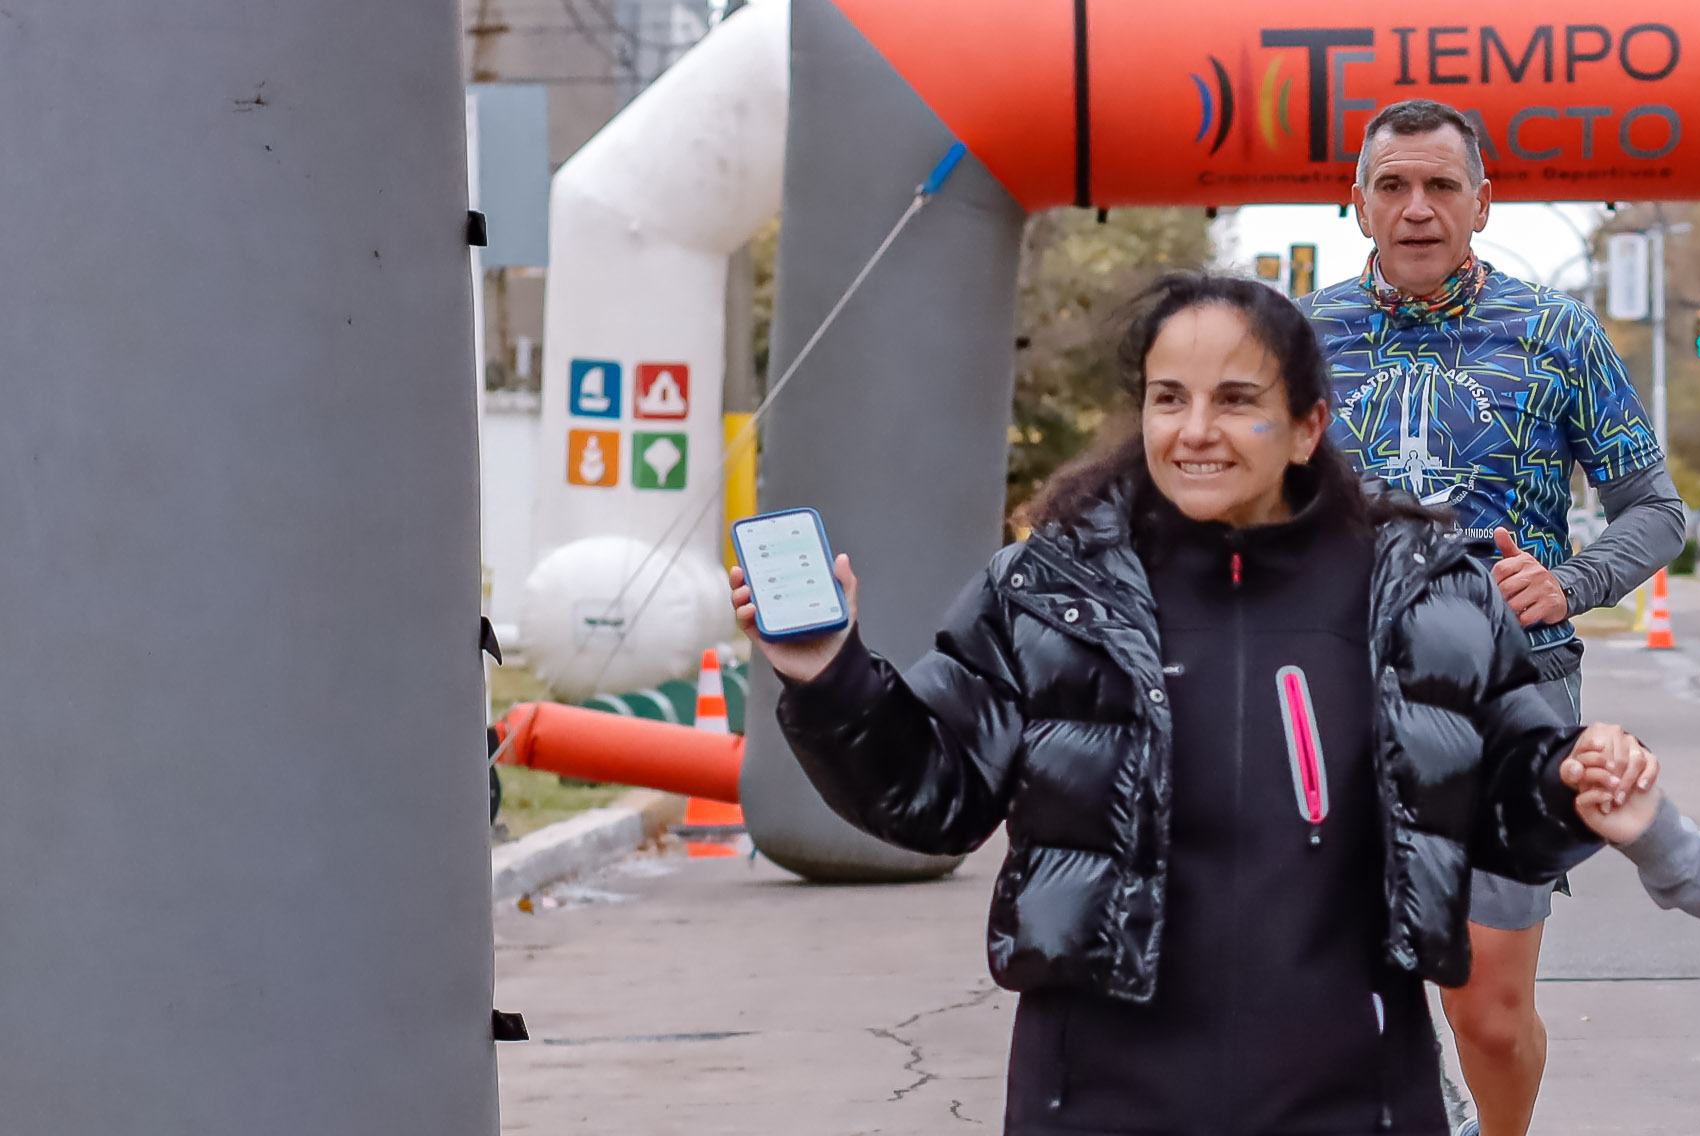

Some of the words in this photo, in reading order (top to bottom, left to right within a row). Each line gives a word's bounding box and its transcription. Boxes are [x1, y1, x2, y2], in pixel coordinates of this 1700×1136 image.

[1340, 366, 1402, 419] MARATÓN
[1408, 362, 1419, 376] X
[1426, 363, 1440, 375] EL
[1445, 369, 1492, 423] AUTISMO
[1464, 528, 1494, 539] UNIDOS
